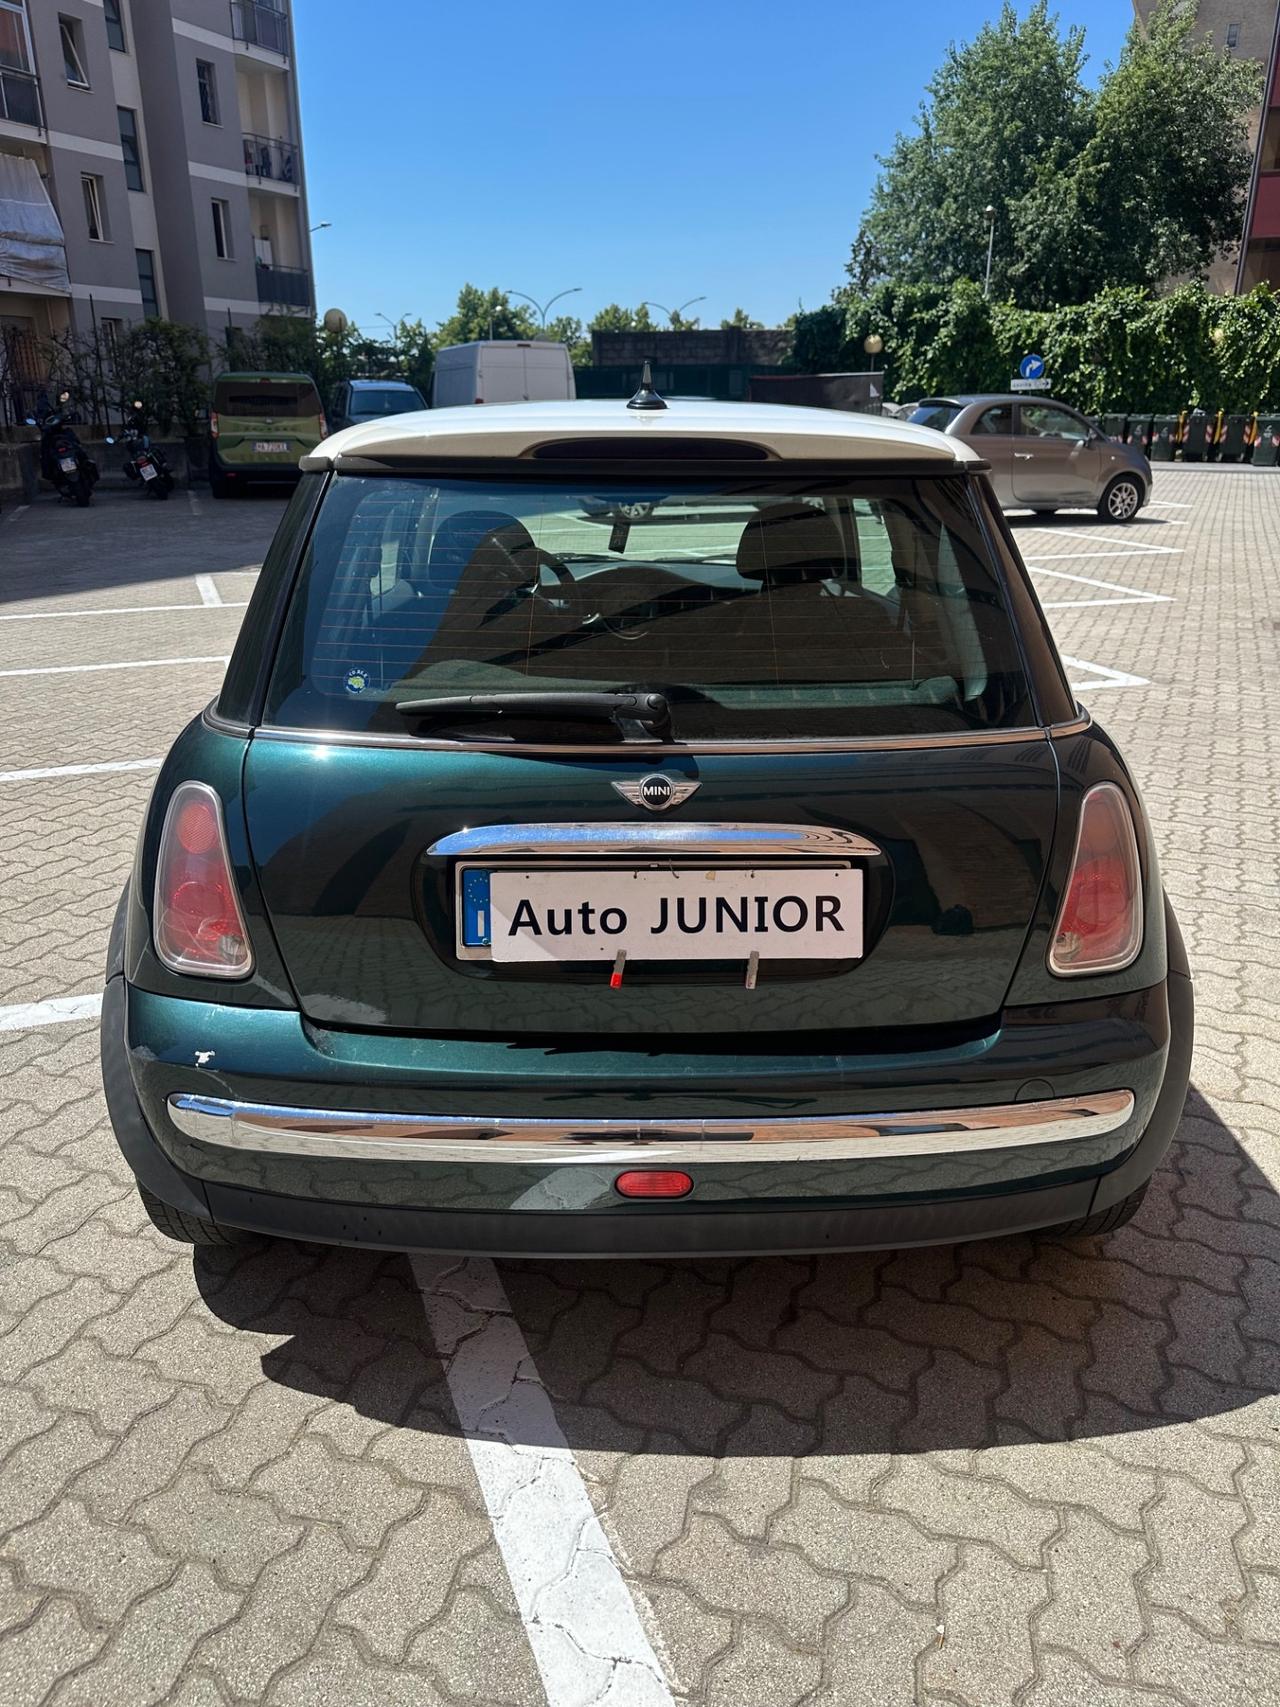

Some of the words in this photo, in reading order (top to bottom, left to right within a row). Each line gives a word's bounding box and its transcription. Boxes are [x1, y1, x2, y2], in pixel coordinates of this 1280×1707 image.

[643, 786, 670, 796] MINI
[477, 910, 485, 937] I
[508, 899, 628, 936] Auto
[650, 895, 845, 934] JUNIOR
